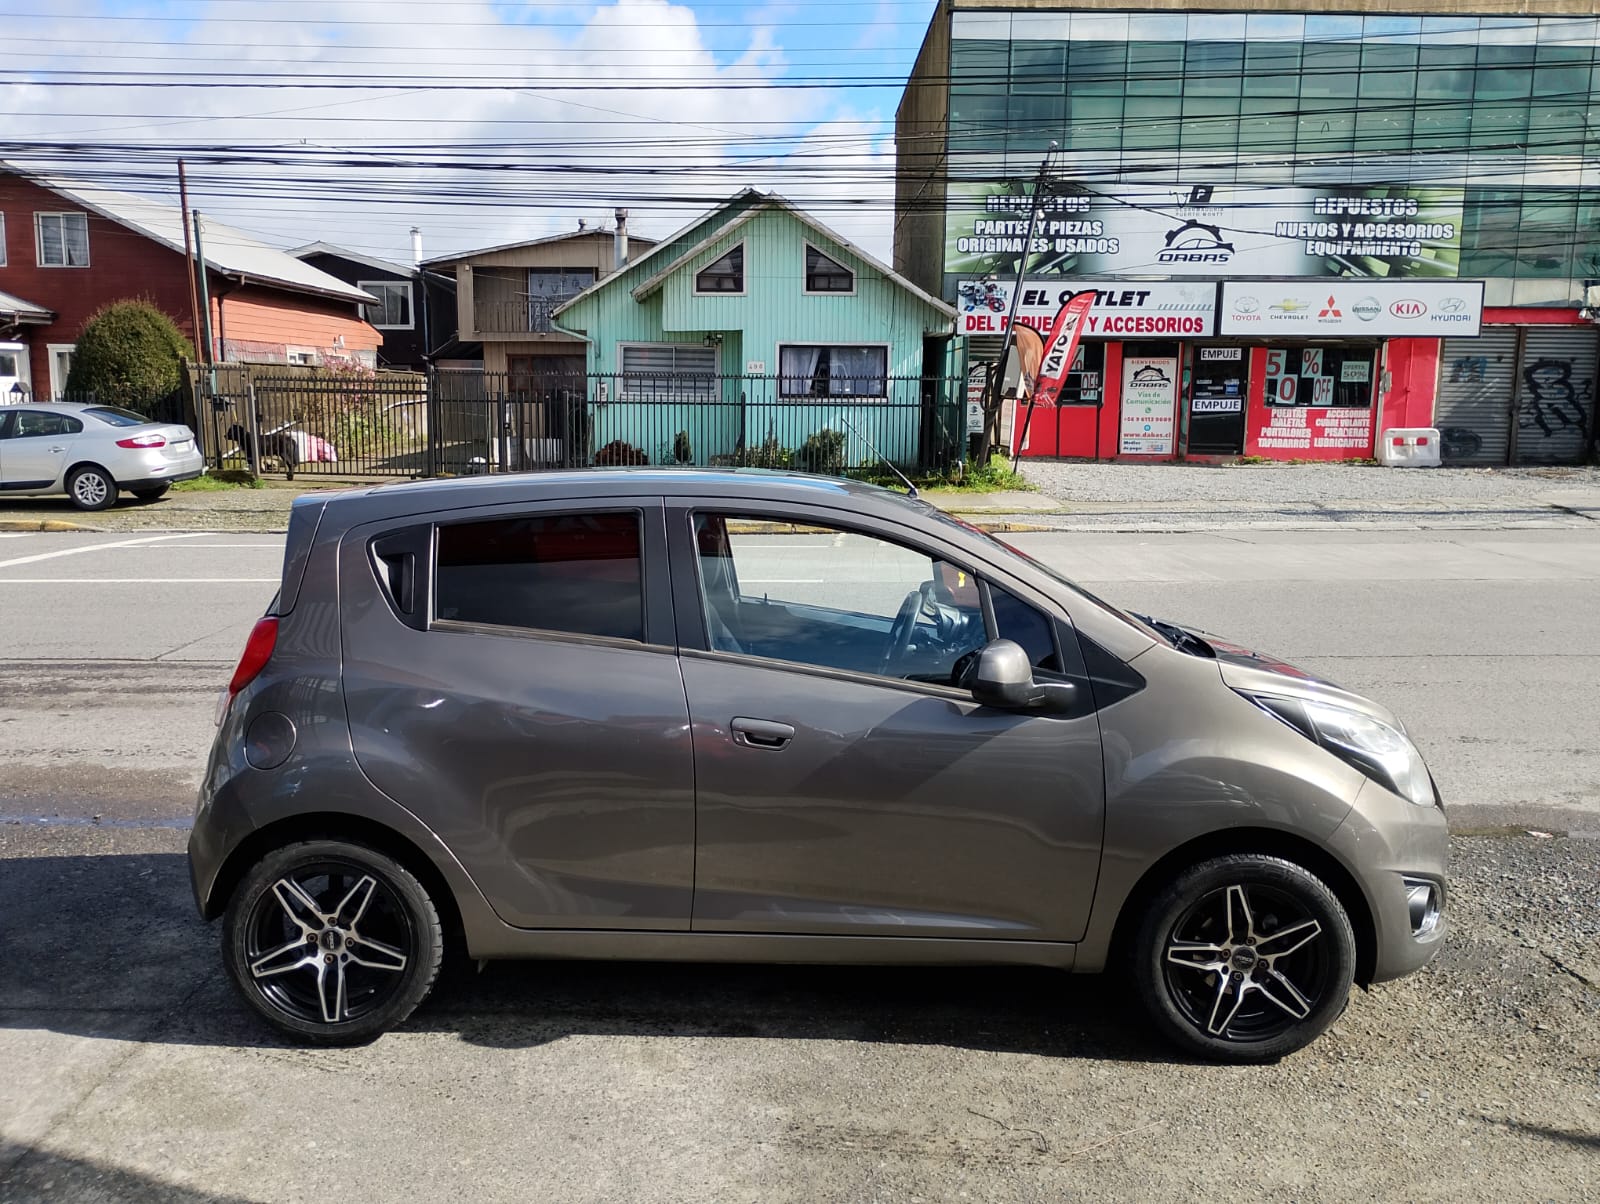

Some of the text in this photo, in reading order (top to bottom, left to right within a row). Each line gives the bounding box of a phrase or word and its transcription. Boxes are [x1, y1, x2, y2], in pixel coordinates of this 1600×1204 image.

[987, 195, 1091, 212] REPUSTOS
[1314, 197, 1418, 216] REPUESTOS
[976, 220, 1103, 236] PARTES Y PIEZAS
[1276, 222, 1454, 239] NUEVOS Y ACCESORIOS
[1055, 238, 1119, 254] USADOS
[1305, 241, 1422, 256] EQUIPAMIENTO
[1158, 254, 1231, 262] DABAS
[1022, 290, 1151, 306] EL OTLET
[1395, 304, 1421, 314] KIA
[1431, 314, 1471, 322] HYUNDAI
[965, 316, 996, 332] DEL
[1088, 316, 1098, 332] Y
[1102, 317, 1204, 334] ACCESORIOS
[1044, 334, 1069, 374] YATO
[1202, 350, 1239, 359] EMPUJE
[1267, 350, 1319, 377] 5 %
[1314, 378, 1332, 402] OFF
[1194, 400, 1240, 410] EMPUJE
[1271, 408, 1308, 418] PUERTAS
[1326, 410, 1371, 418] ACCESORIOS
[1270, 418, 1307, 428] MALETAS
[1340, 418, 1370, 427] VOLANTE
[1260, 427, 1312, 438] PORTALONES
[1324, 428, 1370, 438] PISADERAS
[1258, 438, 1310, 448] TAPABARROS
[1314, 438, 1369, 448] LUBRICANTES
